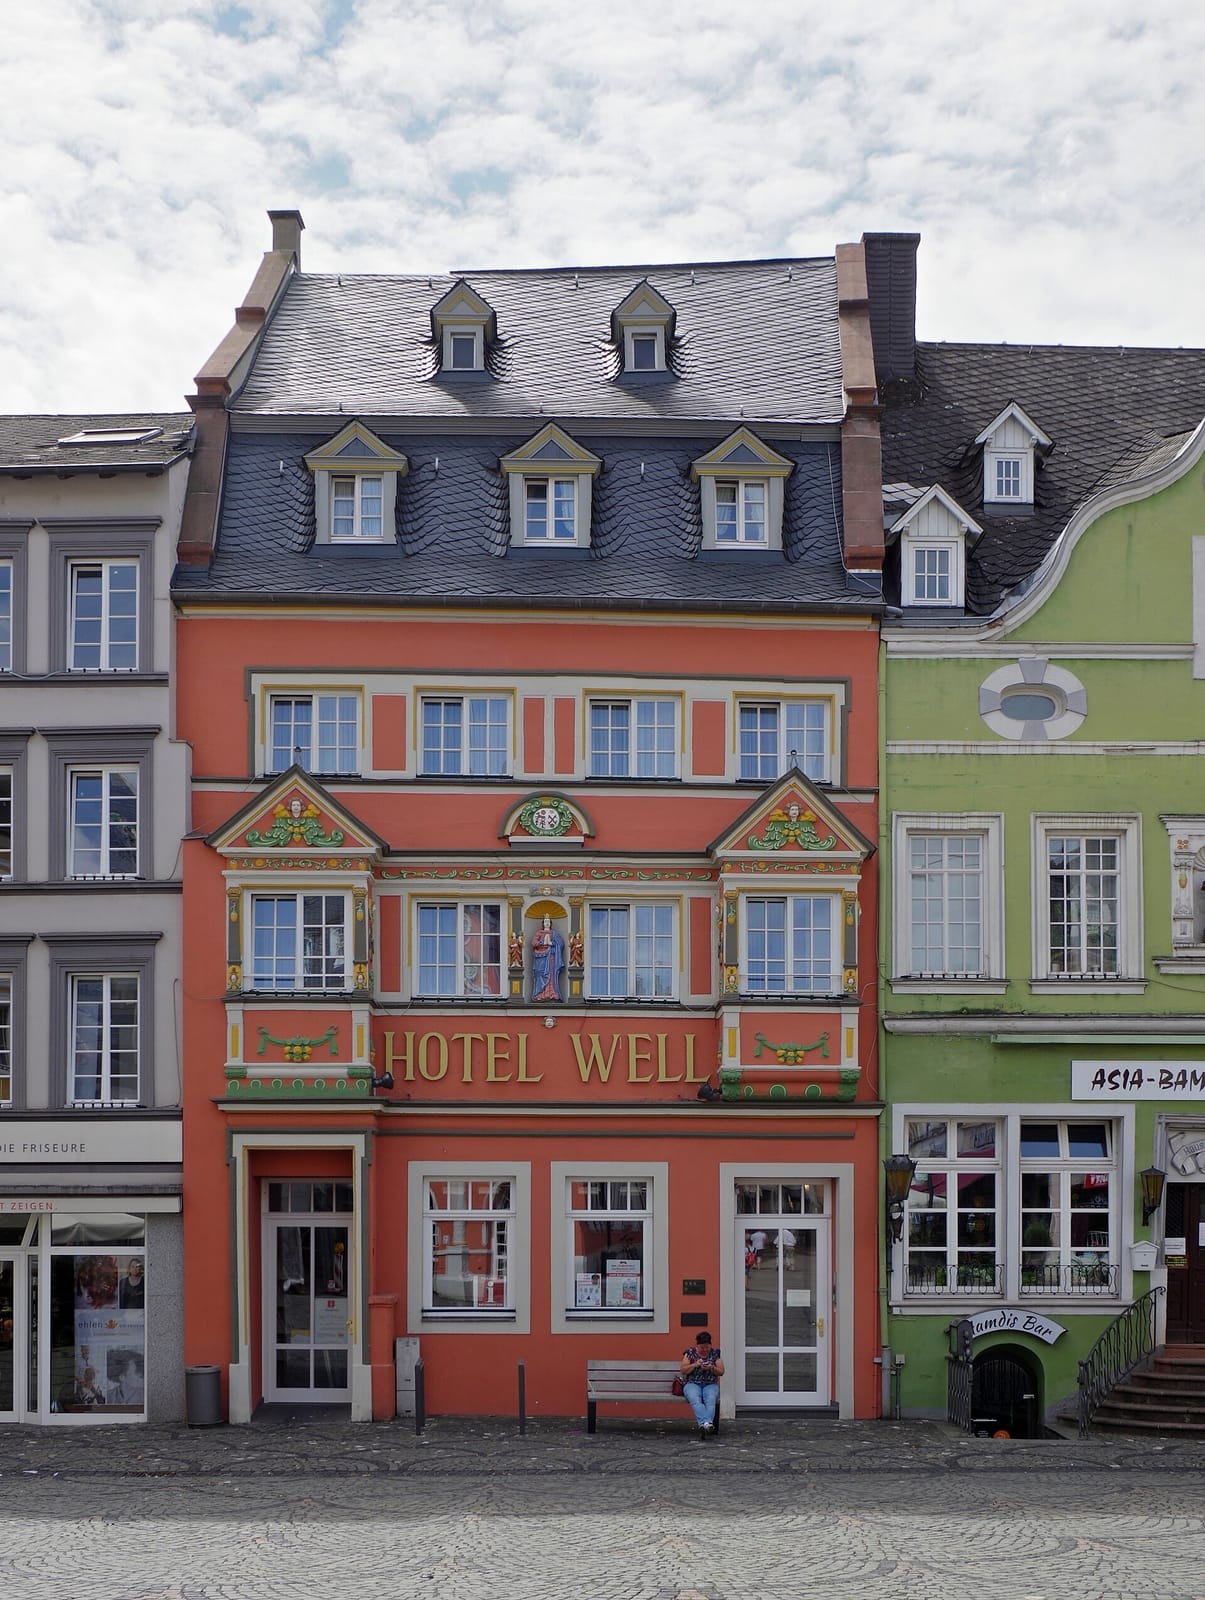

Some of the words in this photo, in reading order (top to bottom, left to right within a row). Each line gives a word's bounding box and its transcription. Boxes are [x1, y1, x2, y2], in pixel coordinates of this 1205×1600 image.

[383, 1031, 545, 1083] HOTEL
[569, 1032, 712, 1083] WELL
[1091, 1068, 1205, 1092] ASIA-BAM
[22, 1143, 86, 1153] FRISEURE
[11, 1202, 58, 1210] ZEIGEN.
[1022, 1315, 1053, 1337] Bar
